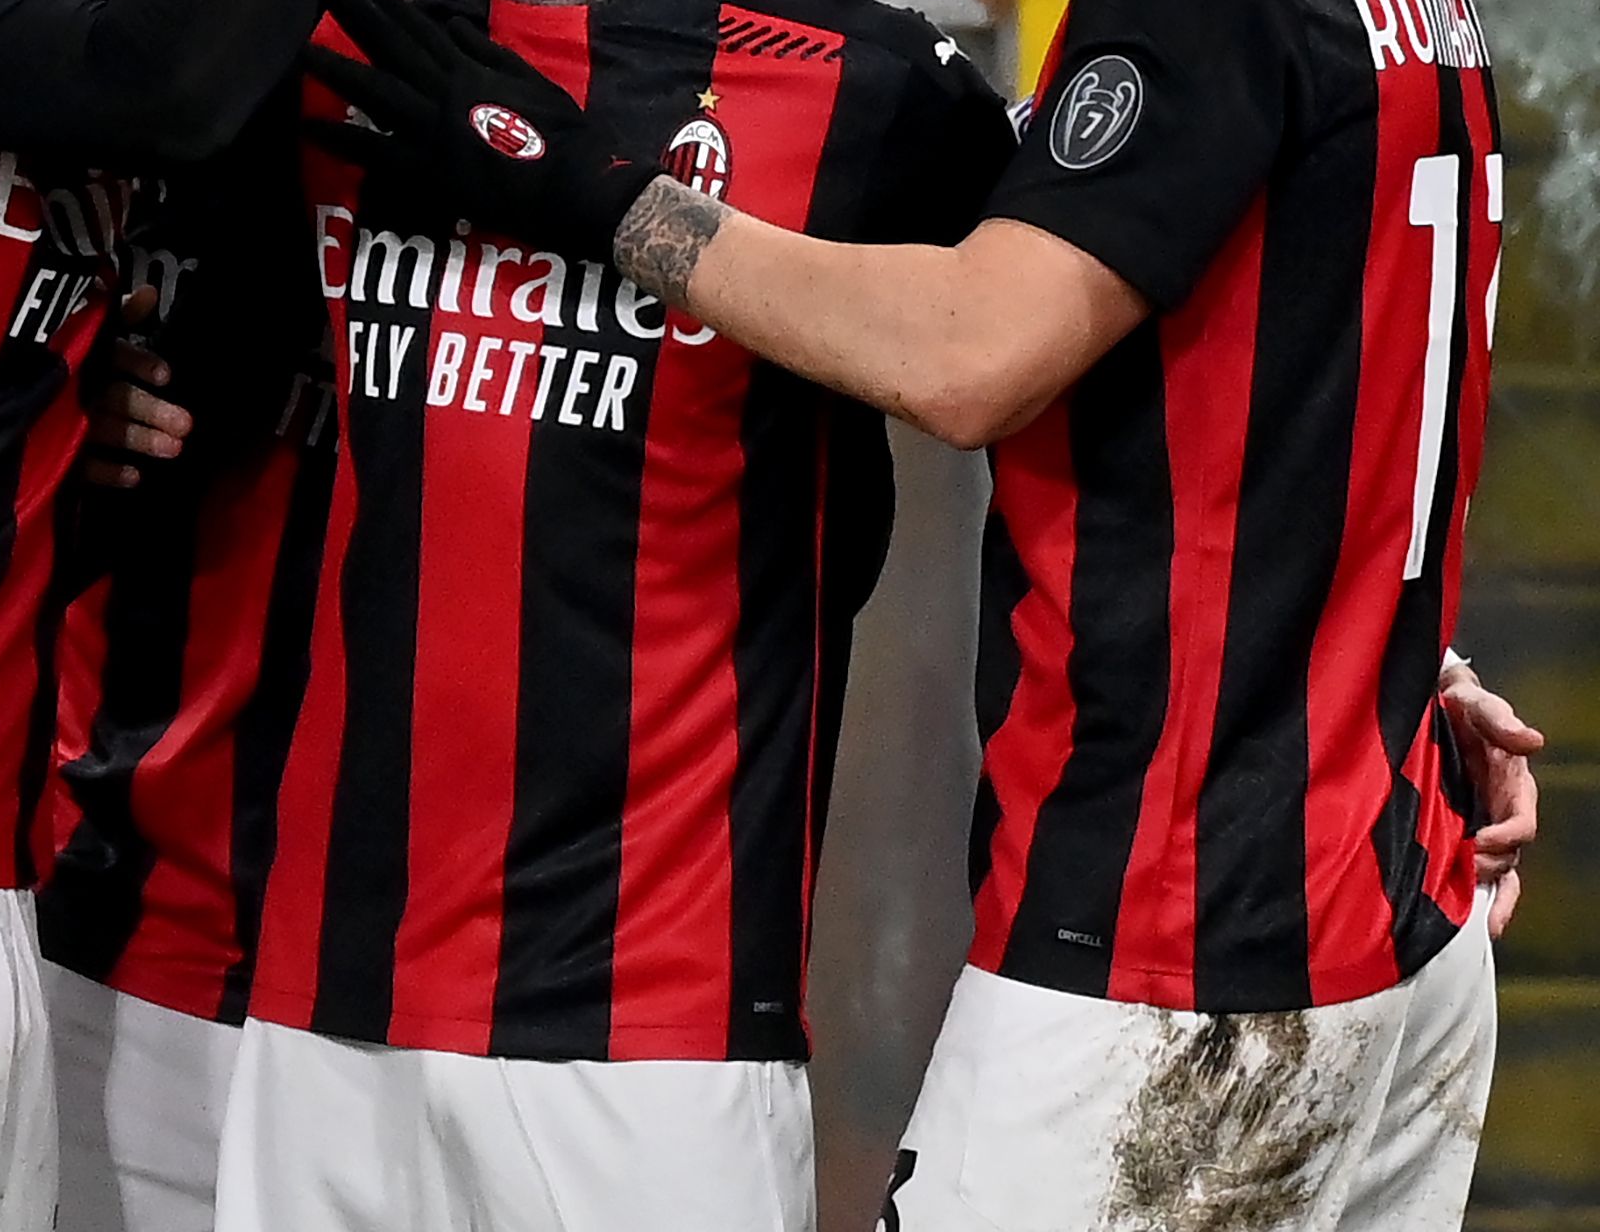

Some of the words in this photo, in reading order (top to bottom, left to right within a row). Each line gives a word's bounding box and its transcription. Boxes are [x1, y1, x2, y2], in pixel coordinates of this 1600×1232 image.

[681, 124, 720, 147] ACM
[1080, 111, 1104, 139] 7
[348, 320, 416, 400] FLY
[426, 331, 639, 431] BETTER
